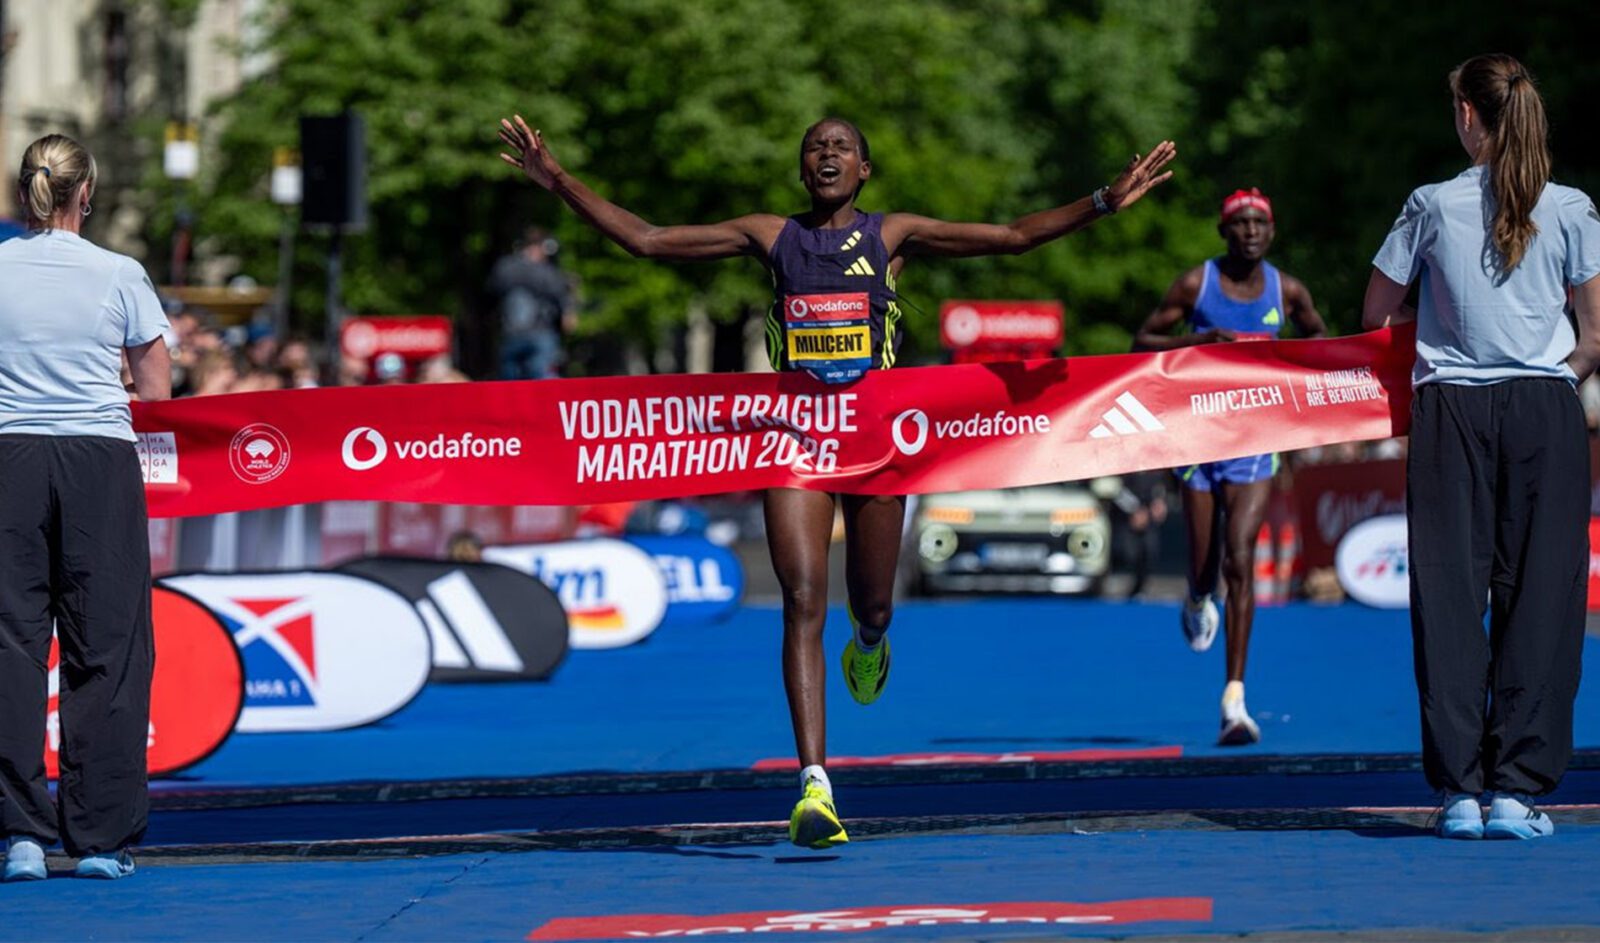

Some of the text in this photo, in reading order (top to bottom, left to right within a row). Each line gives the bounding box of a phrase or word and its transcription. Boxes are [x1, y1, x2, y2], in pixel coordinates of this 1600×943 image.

[809, 300, 863, 312] vodafone
[794, 333, 864, 354] MILICENT
[1305, 374, 1323, 391] ALL
[1306, 390, 1328, 407] ARE
[558, 393, 858, 440] VODAFONE PRAGUE
[935, 410, 1051, 439] vodafone
[393, 432, 521, 459] vodafone
[577, 430, 839, 483] MARATHON 2026
